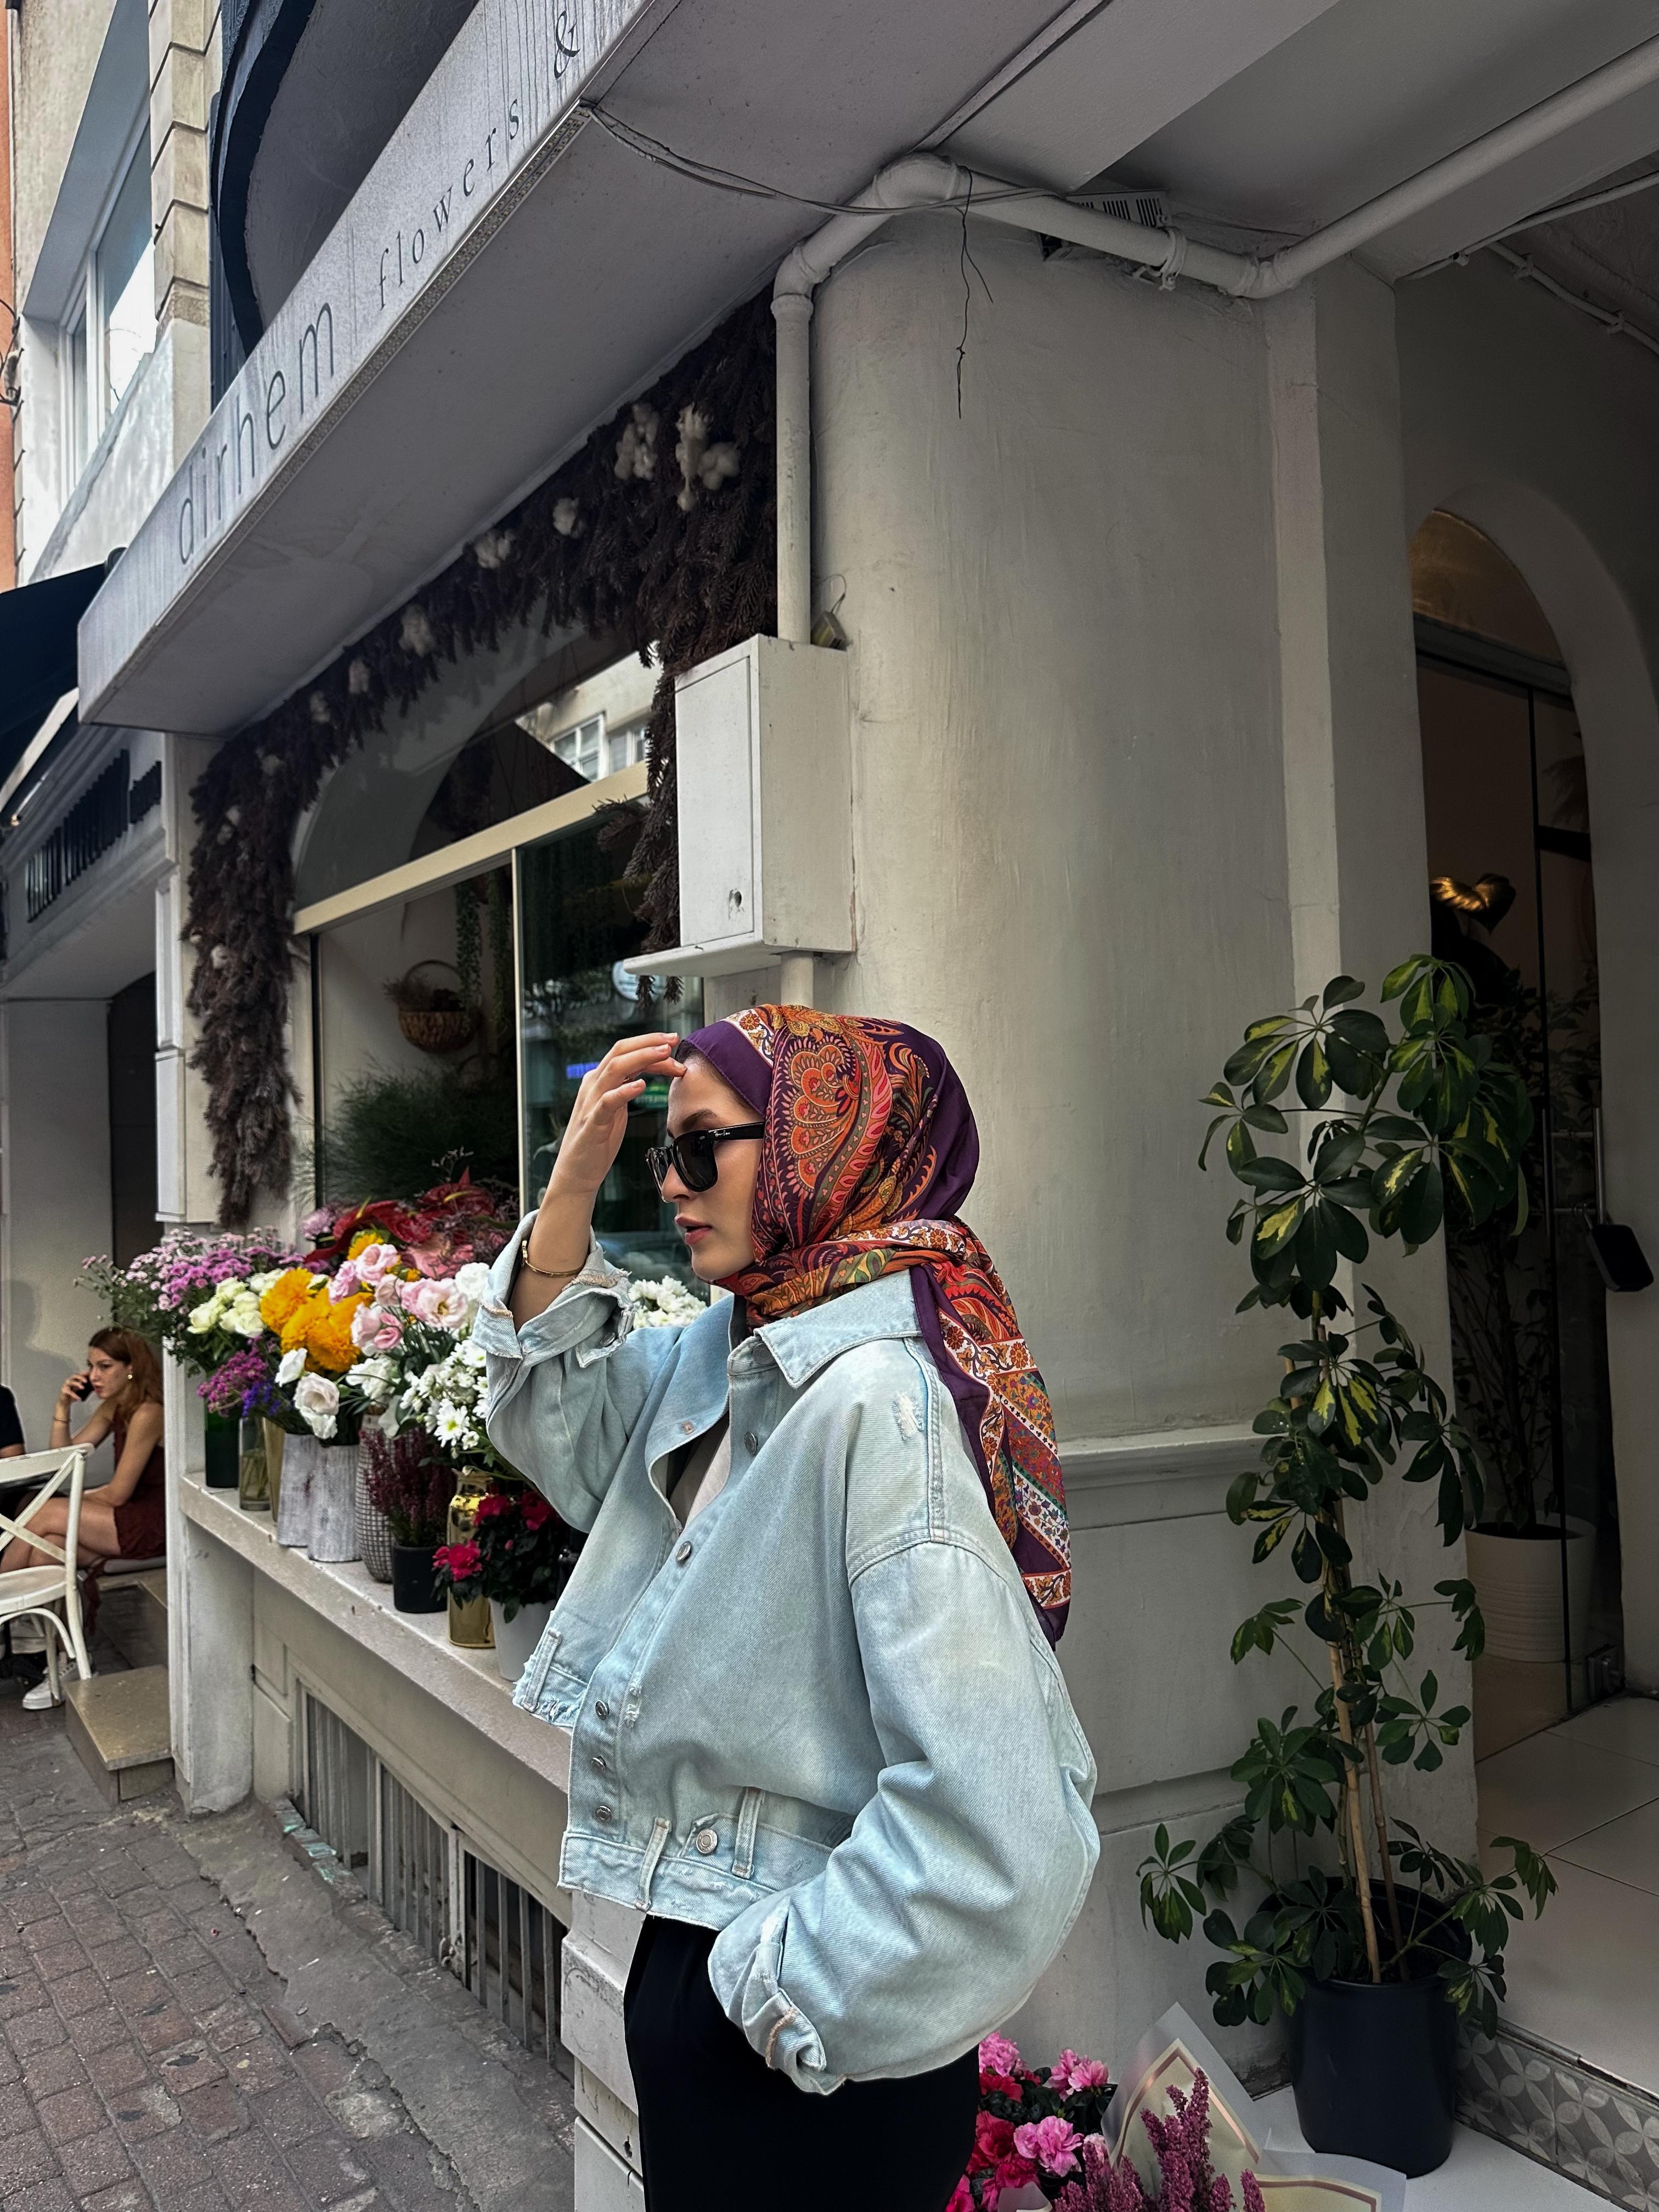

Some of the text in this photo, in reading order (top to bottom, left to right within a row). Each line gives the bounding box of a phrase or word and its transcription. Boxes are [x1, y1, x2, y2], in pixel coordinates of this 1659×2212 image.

[179, 10, 580, 565] dirhem flowers &
